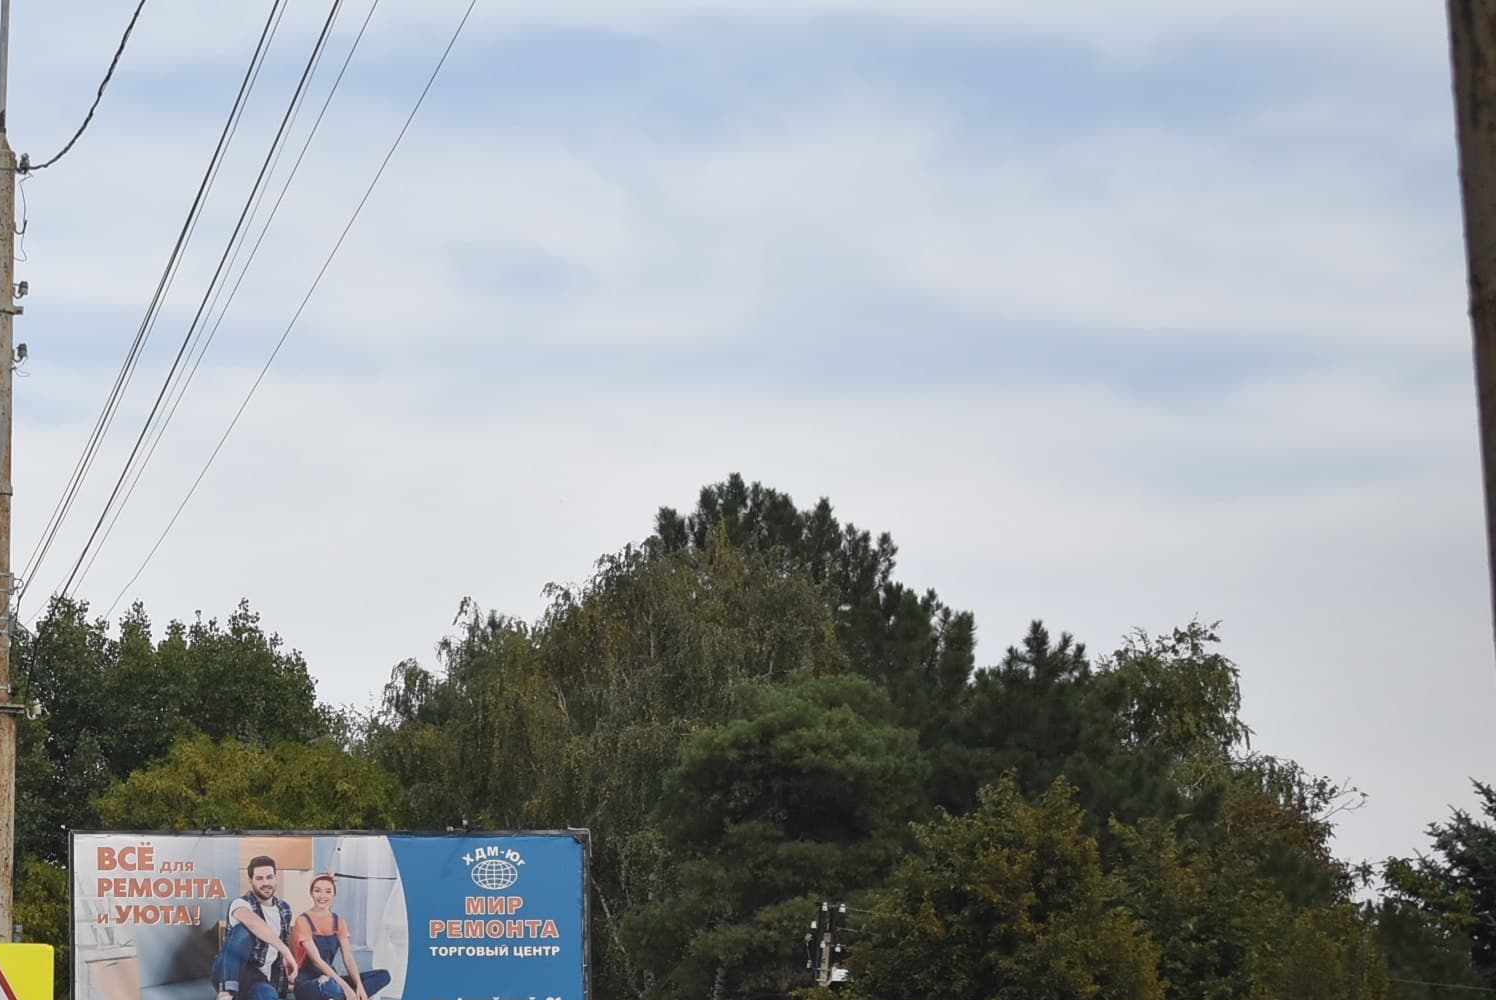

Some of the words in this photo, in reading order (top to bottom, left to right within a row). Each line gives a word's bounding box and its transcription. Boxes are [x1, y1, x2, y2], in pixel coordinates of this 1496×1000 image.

[97, 841, 155, 872] ВСЁ
[159, 860, 194, 874] для
[97, 877, 227, 899] РЕМОНТА
[98, 911, 109, 925] и
[115, 904, 201, 926] УЮТА!
[465, 896, 524, 916] МИР
[429, 919, 560, 939] РЕМОНТА
[429, 944, 509, 957] ТОРГОВЫЙ
[513, 946, 560, 958] ЦЕНТР
